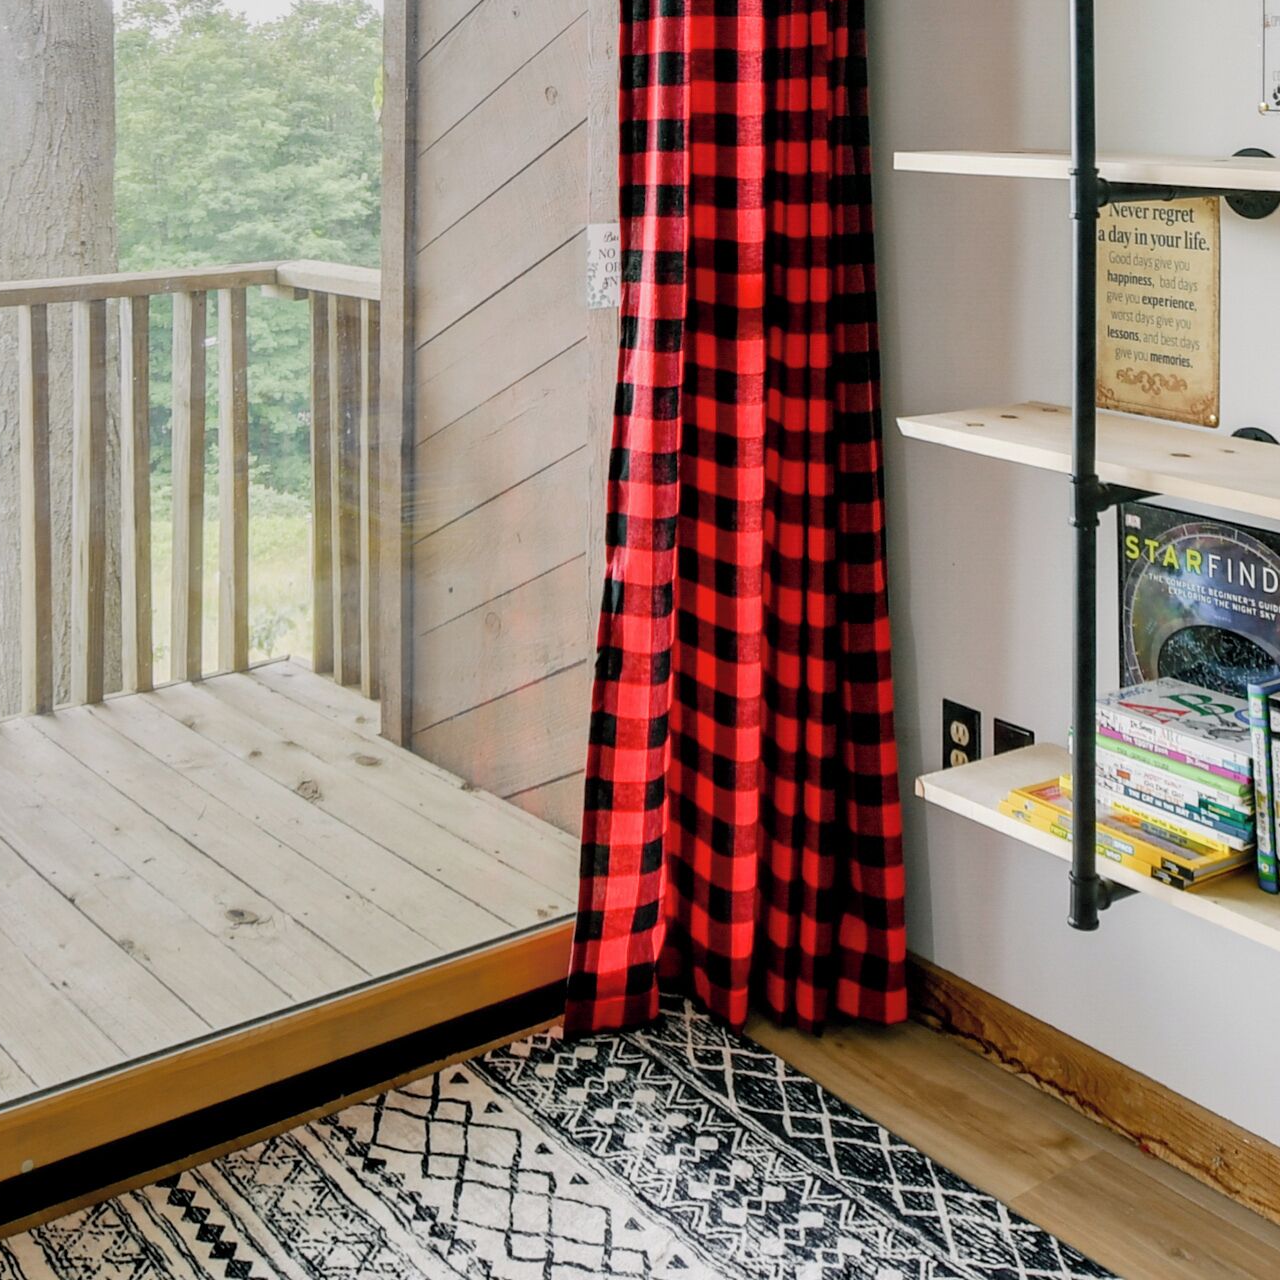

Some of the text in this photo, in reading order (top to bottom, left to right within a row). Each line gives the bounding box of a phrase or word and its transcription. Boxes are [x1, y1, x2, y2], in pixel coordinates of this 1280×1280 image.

[1108, 202, 1195, 226] Never regret
[1098, 225, 1211, 252] a day in your life.
[1108, 250, 1191, 274] Good days give you
[1107, 270, 1198, 294] happiness, bad days
[1106, 289, 1198, 312] give you experience,
[1110, 308, 1192, 332] worst days give you
[1107, 324, 1201, 351] lessons, and best days
[1115, 345, 1194, 369] give you memories.
[1148, 573, 1163, 584] THE
[1166, 577, 1206, 596] COMPLETE
[1207, 586, 1256, 608] BEGINNER'S
[1168, 586, 1277, 622] EXPLORING THE NIGHT SKY
